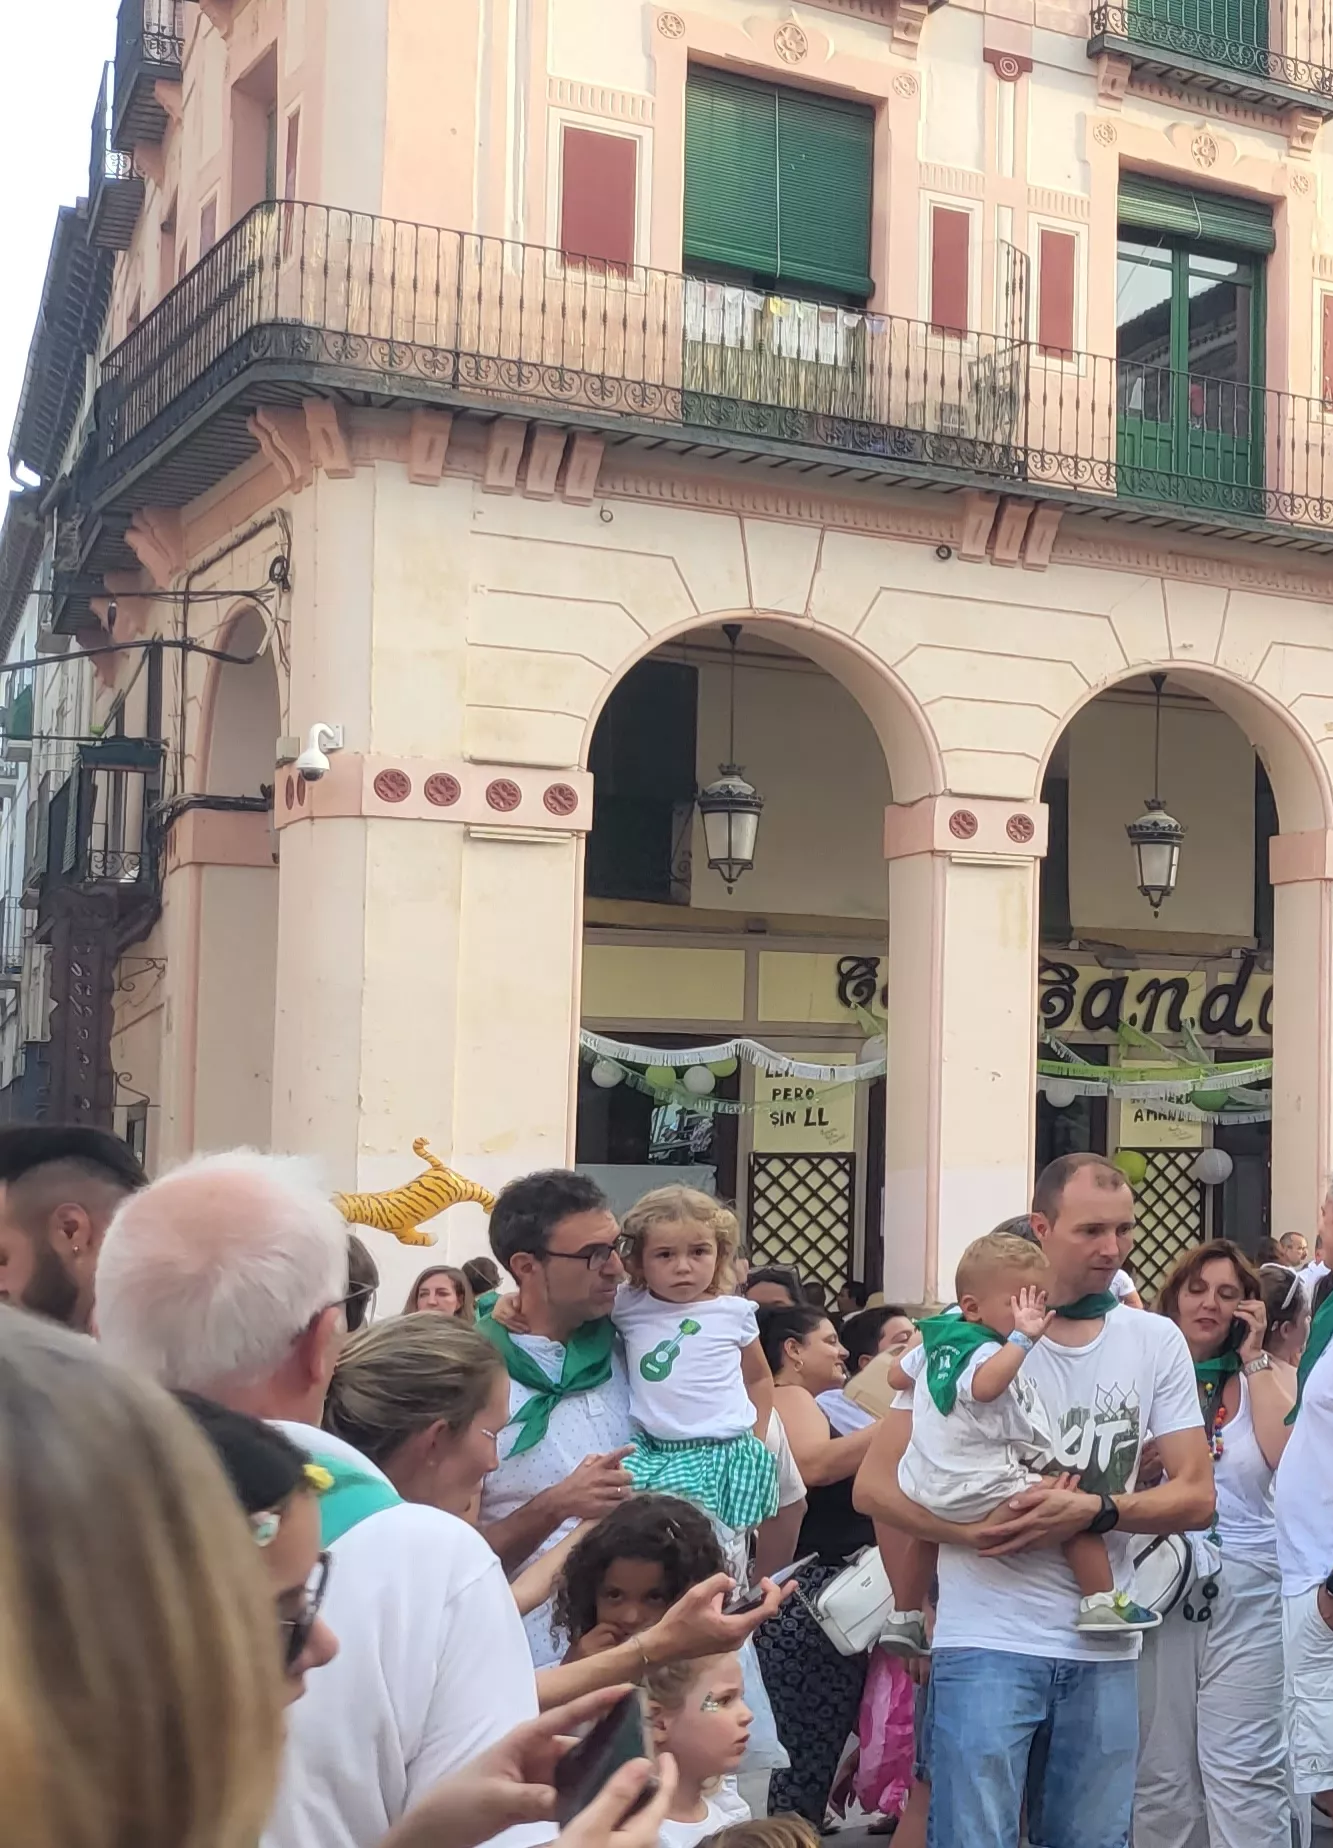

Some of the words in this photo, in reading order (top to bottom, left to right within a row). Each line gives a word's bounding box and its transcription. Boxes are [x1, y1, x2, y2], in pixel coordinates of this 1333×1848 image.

[772, 1087, 815, 1101] PERO
[769, 1110, 796, 1127] SIN
[803, 1107, 829, 1127] LL
